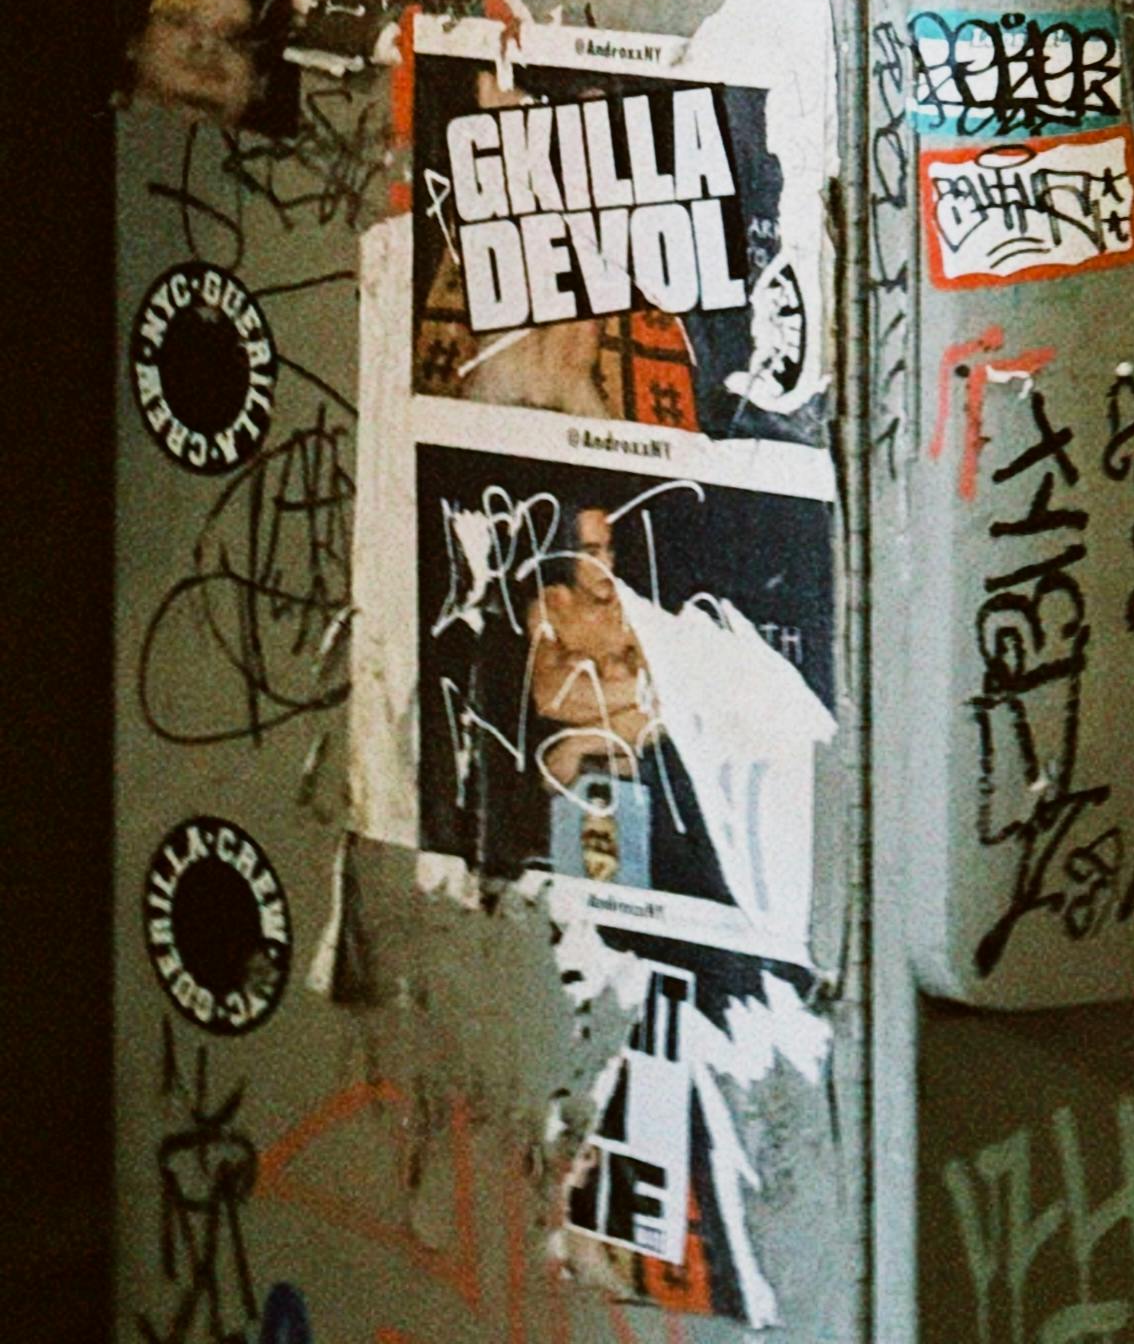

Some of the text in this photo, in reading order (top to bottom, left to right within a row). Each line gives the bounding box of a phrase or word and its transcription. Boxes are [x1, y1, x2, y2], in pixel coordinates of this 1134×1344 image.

[446, 87, 736, 224] GKILLA
[141, 273, 193, 350] NYC
[459, 198, 747, 332] DEVOL
[135, 362, 207, 468] CREW
[216, 826, 289, 945] CREW
